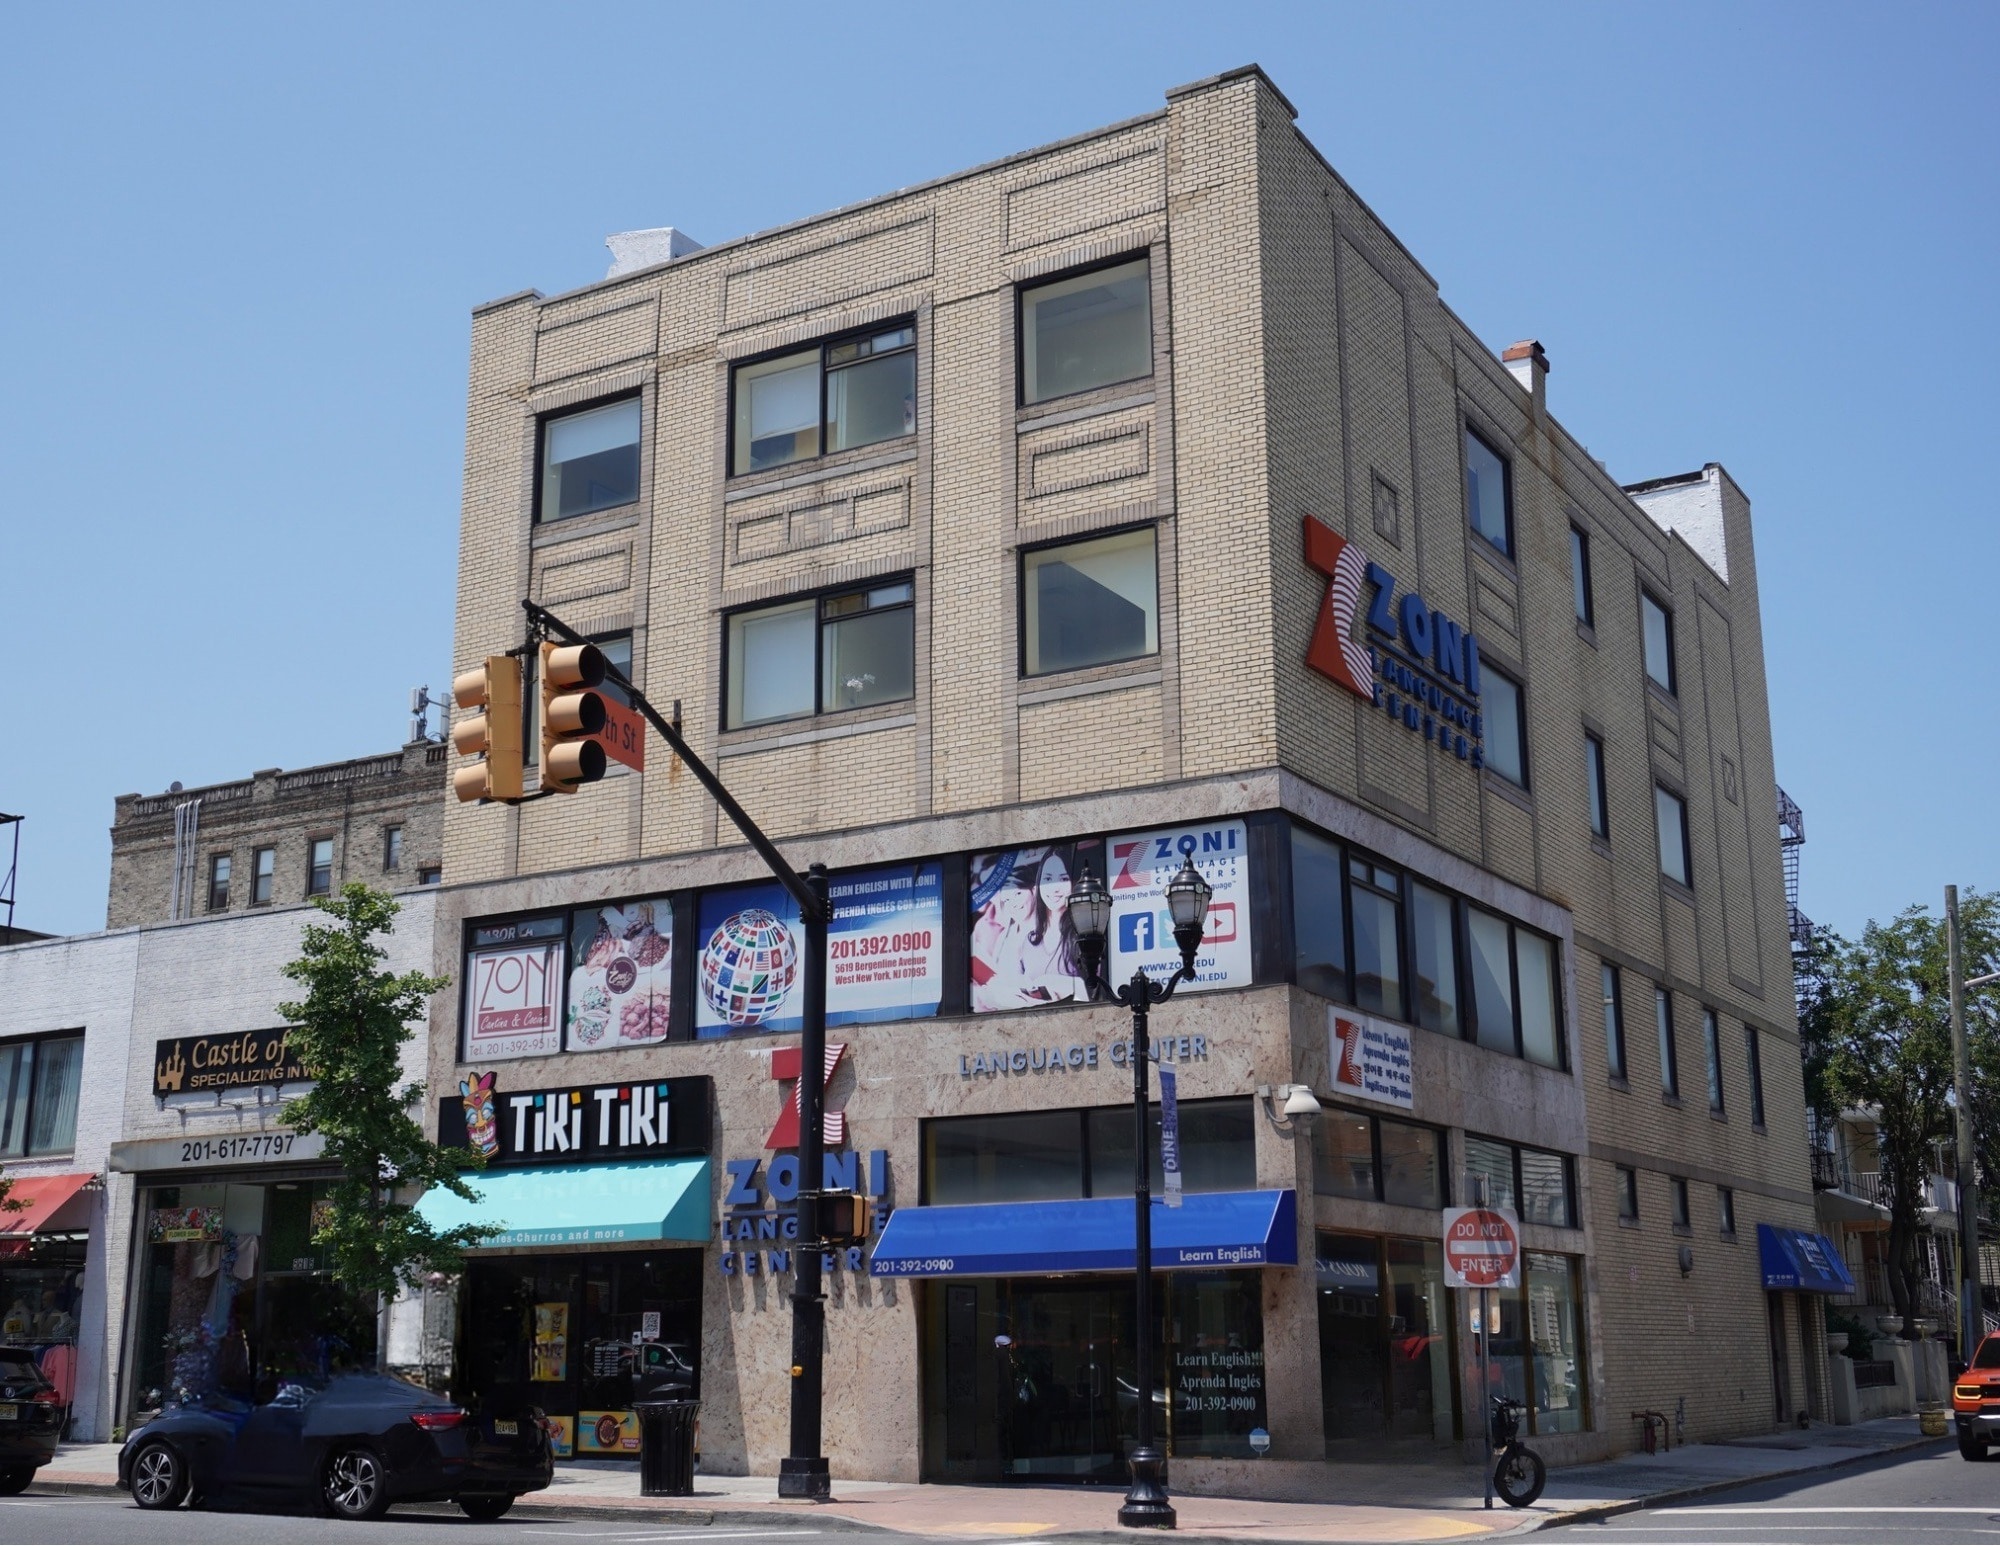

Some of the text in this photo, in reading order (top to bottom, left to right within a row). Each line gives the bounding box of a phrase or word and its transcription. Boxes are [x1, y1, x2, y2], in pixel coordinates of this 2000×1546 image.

[1366, 562, 1480, 696] ZONI
[1369, 646, 1483, 738] LANGUAGE
[1372, 683, 1485, 769] CENTERS
[622, 722, 636, 753] St
[1155, 857, 1237, 874] LANUAGE
[1155, 868, 1237, 885] CEERS
[828, 884, 854, 898] LEARN
[854, 879, 889, 894] ENGLISH
[890, 876, 913, 890] WITH
[1137, 889, 1149, 898] the
[867, 899, 896, 915] INGLÉS
[897, 898, 914, 911] CON
[915, 896, 939, 909] ZONI!
[830, 930, 932, 959] 201.392.0900
[835, 956, 927, 974] 5619 Bergenline Avenue
[1142, 958, 1216, 973] WWW.ZO.EDU
[479, 951, 554, 1012] ZONI
[835, 974, 855, 985] West
[856, 973, 872, 983] New
[893, 969, 902, 979] NJ
[902, 967, 927, 978] 07093
[480, 1013, 507, 1031] Cantina
[511, 1012, 520, 1027] &
[469, 1037, 558, 1056] Tel. 201-392-9515
[1362, 1026, 1409, 1051] Learn English
[191, 1032, 259, 1069] Castle
[265, 1028, 293, 1067] of
[957, 1035, 1207, 1076] LANGUAGE CENTER
[190, 1066, 284, 1088] SPECIALIZING
[287, 1065, 300, 1079] IN
[182, 1134, 296, 1162] 201-617-7797
[1163, 1131, 1177, 1171] DINE
[724, 1150, 888, 1205] ZONI
[568, 1229, 590, 1240] and
[594, 1229, 625, 1239] more
[722, 1210, 888, 1241] LANGE
[1457, 1223, 1505, 1237] DO NOT
[719, 1247, 864, 1277] CENER
[1180, 1246, 1261, 1263] Learn English
[875, 1259, 954, 1273] 201-392-0900
[1461, 1258, 1503, 1272] ENTER
[1176, 1352, 1208, 1366] Learn
[1179, 1373, 1261, 1391] Aprenda Inglés
[1185, 1396, 1256, 1411] 201-392-0900
